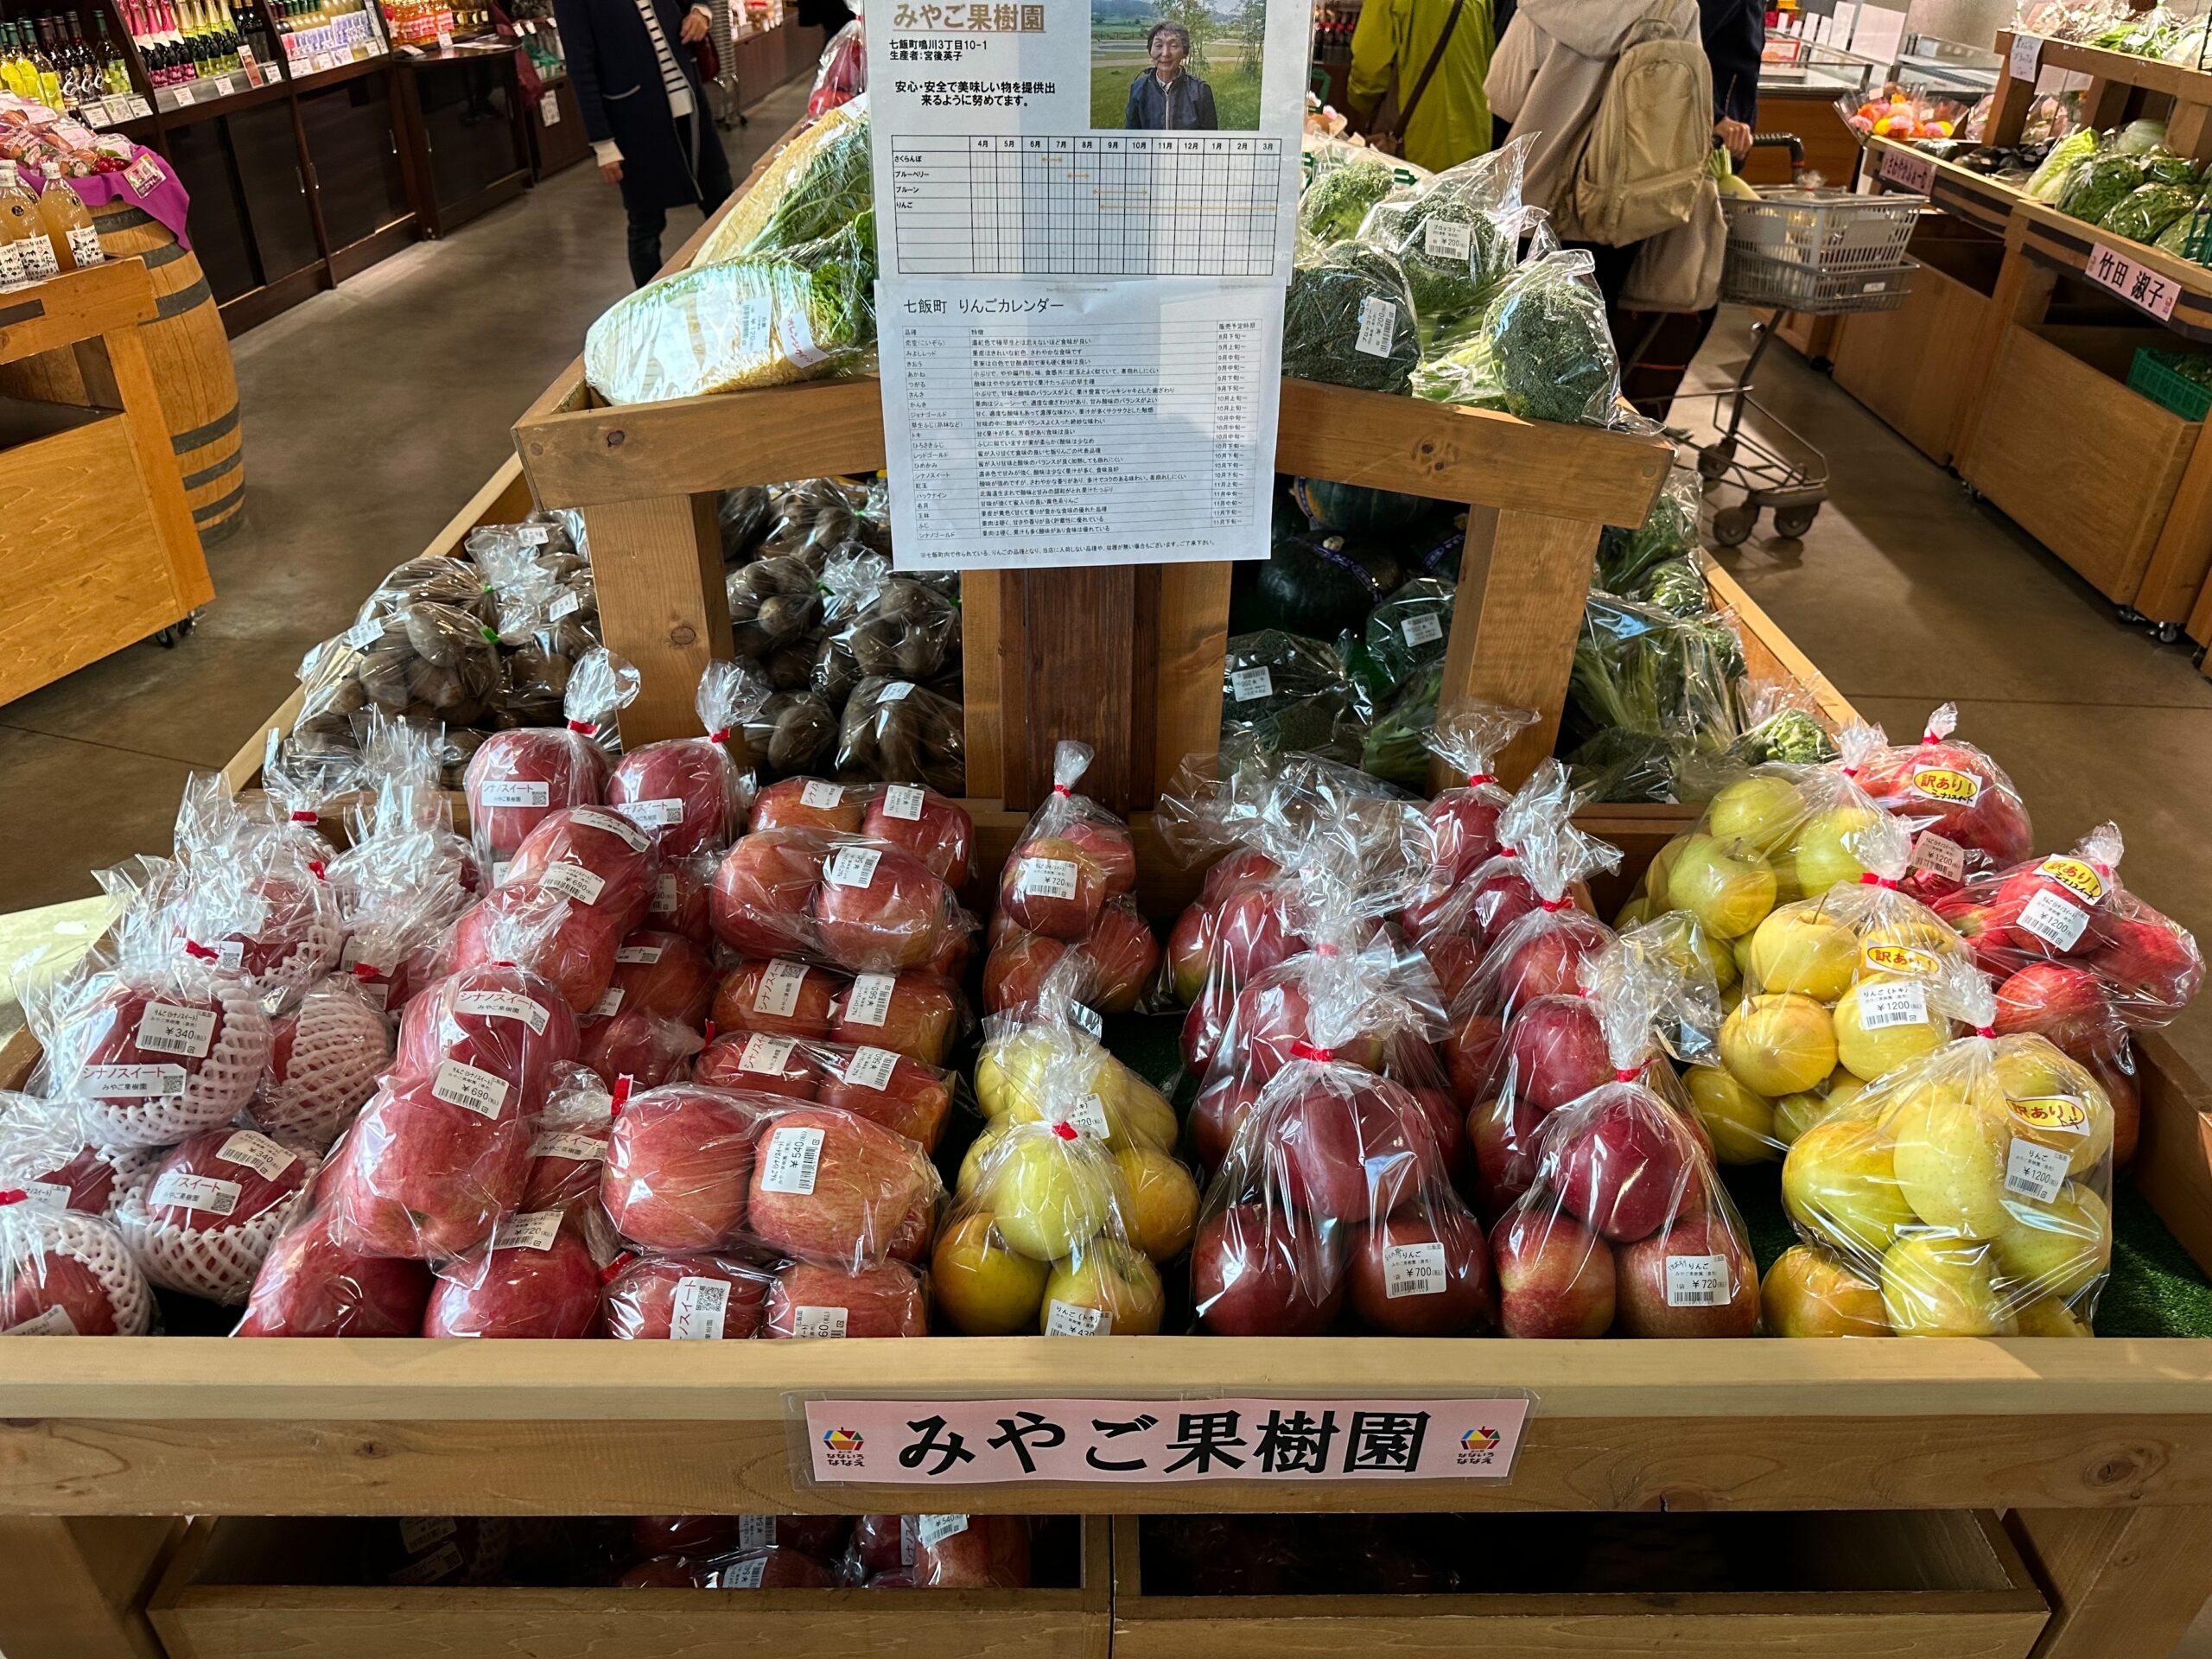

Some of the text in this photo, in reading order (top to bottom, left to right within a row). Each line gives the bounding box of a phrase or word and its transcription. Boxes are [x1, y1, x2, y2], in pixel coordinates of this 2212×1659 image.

[893, 3, 1045, 31] みやご果樹園
[889, 40, 987, 50] 七飯町鳴川3丁目10-1
[895, 81, 1055, 94] 安心・安全で美味しい物を提供出
[921, 95, 1028, 106] 来るように努めてます。
[2098, 251, 2128, 288] 竹田
[904, 298, 1064, 314] 七飯町 りんごカレンダー
[461, 994, 536, 1010] シナノスイート
[83, 1066, 165, 1079] シナノスイート
[899, 1410, 1431, 1475] みやご果樹園
